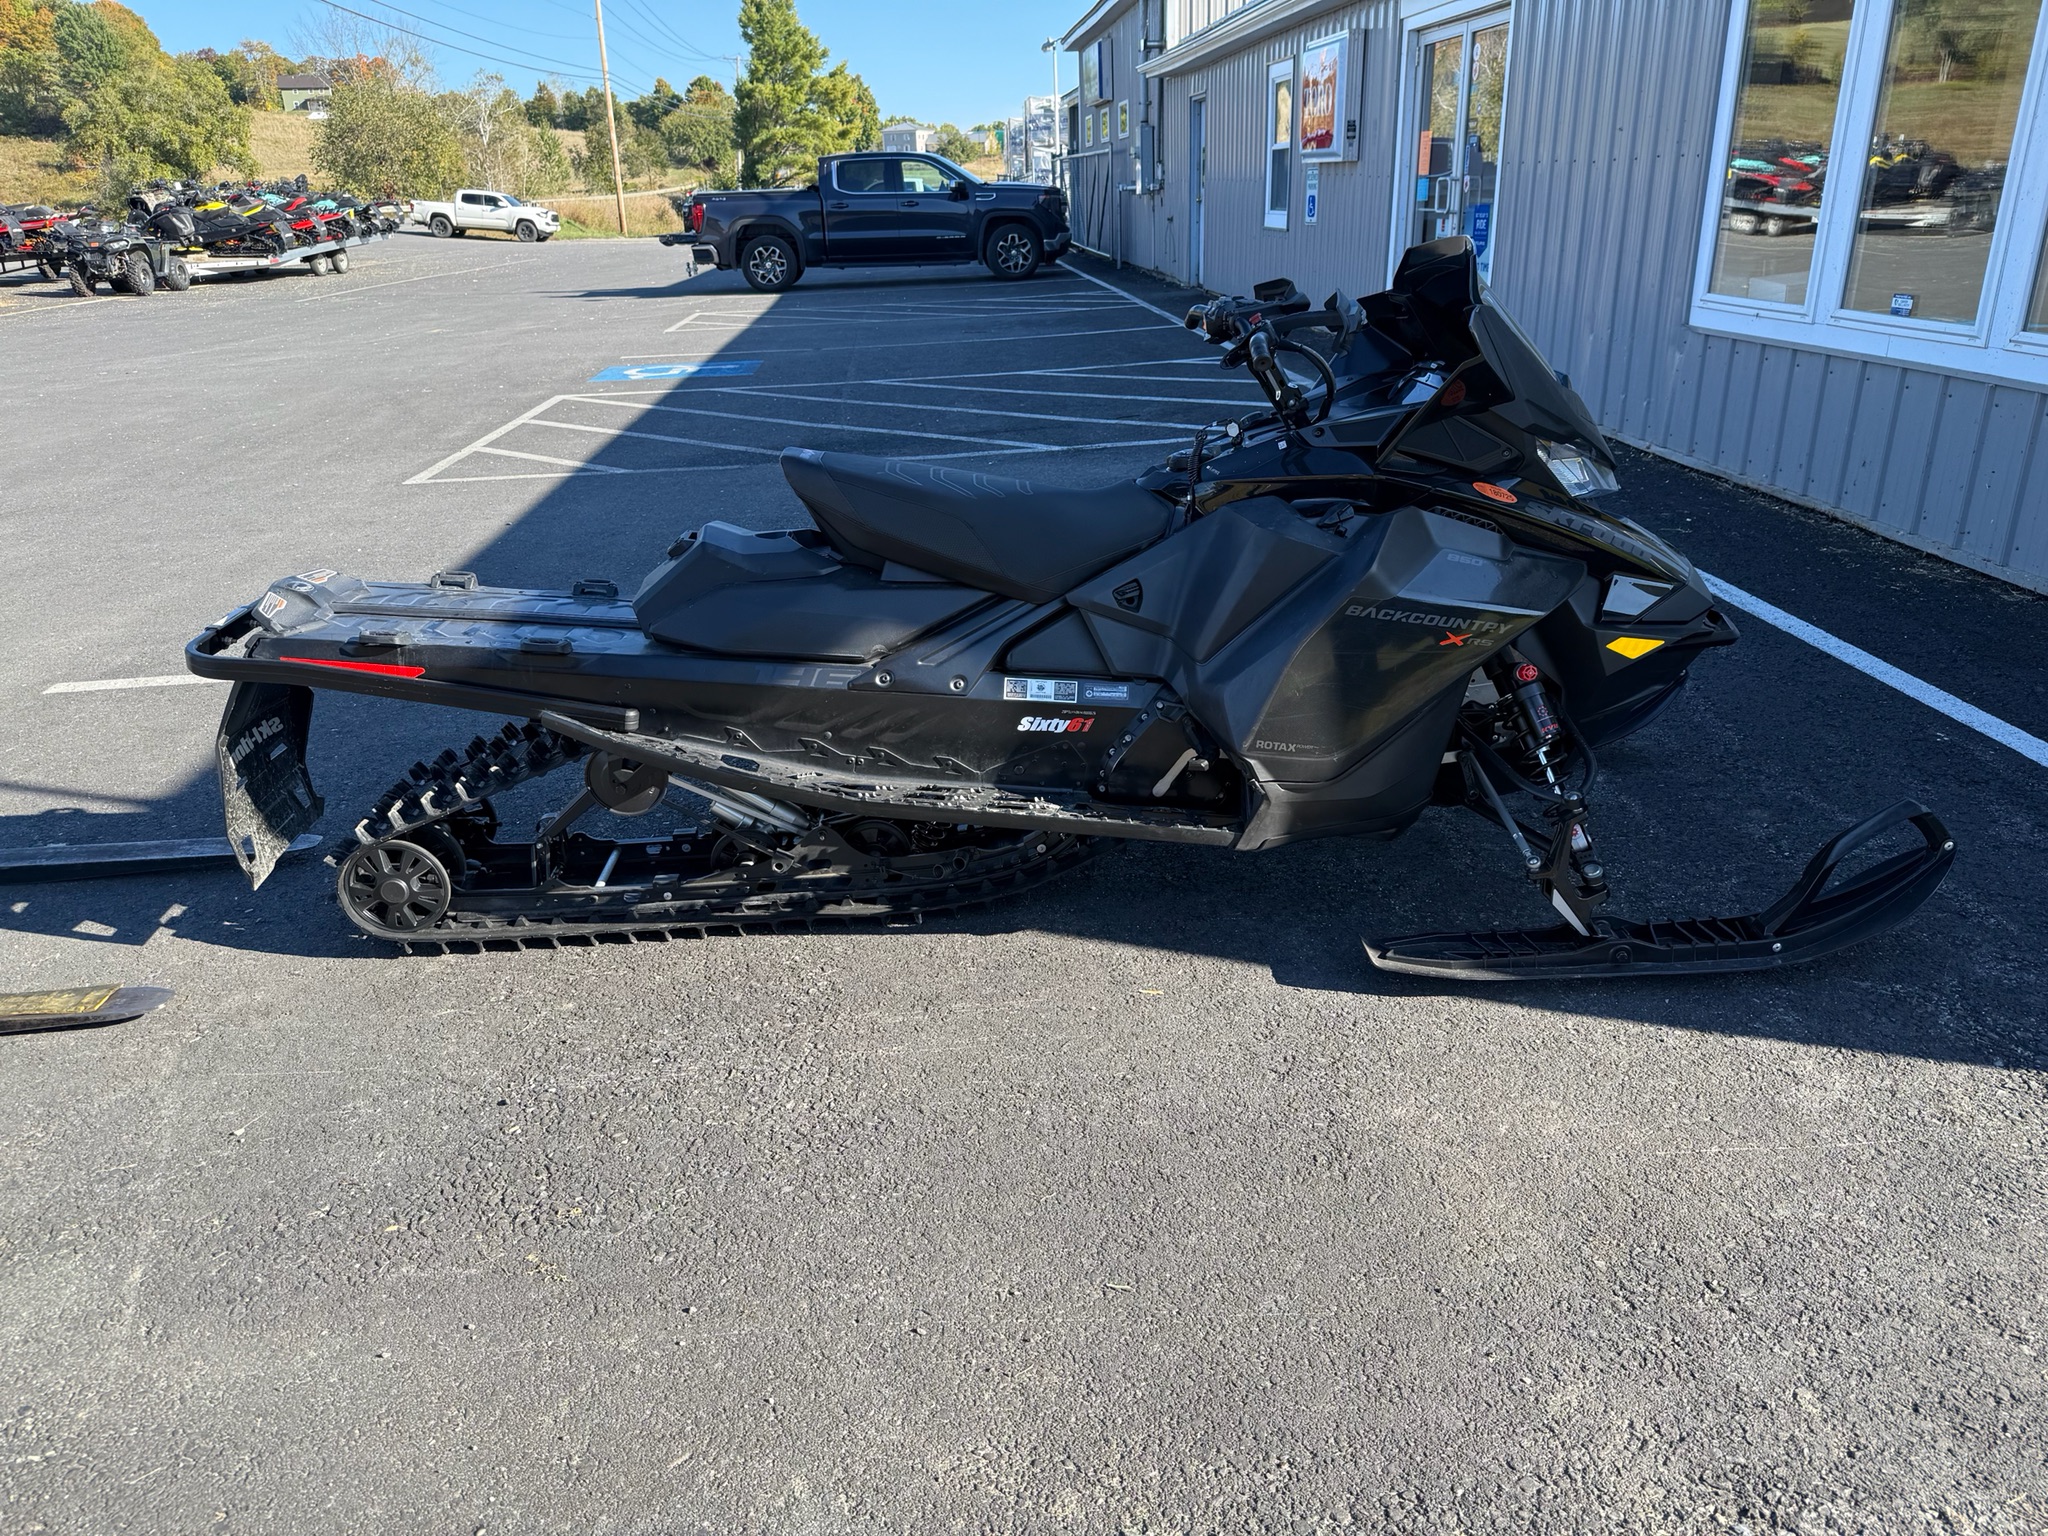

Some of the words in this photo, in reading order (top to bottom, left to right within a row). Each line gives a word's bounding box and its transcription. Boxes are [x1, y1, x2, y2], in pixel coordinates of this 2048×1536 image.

[1303, 82, 1333, 117] TORO
[1447, 553, 1483, 567] 850
[1344, 604, 1514, 634] BACKCOUNTRY
[1017, 715, 1096, 734] Sixty61
[1255, 739, 1297, 753] ROTAX
